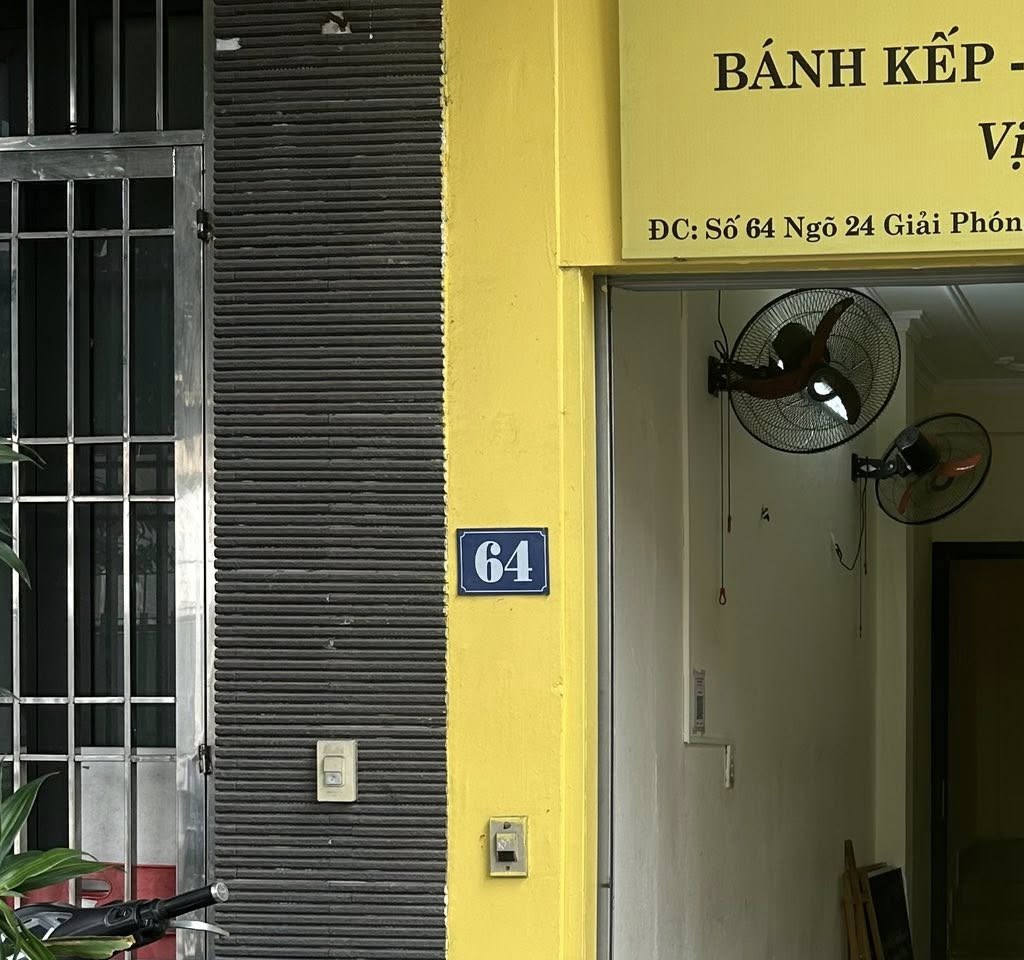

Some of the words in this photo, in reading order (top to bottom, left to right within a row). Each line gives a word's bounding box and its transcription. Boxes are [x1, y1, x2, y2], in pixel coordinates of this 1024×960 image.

[713, 37, 867, 92] BÁNH
[882, 25, 995, 86] KẾP
[648, 218, 698, 241] ĐC:
[705, 214, 741, 240] Số
[745, 217, 776, 239] 64
[783, 216, 838, 243] Ngõ
[844, 214, 876, 237] 24
[883, 210, 942, 236] Giải
[474, 540, 533, 584] 64
